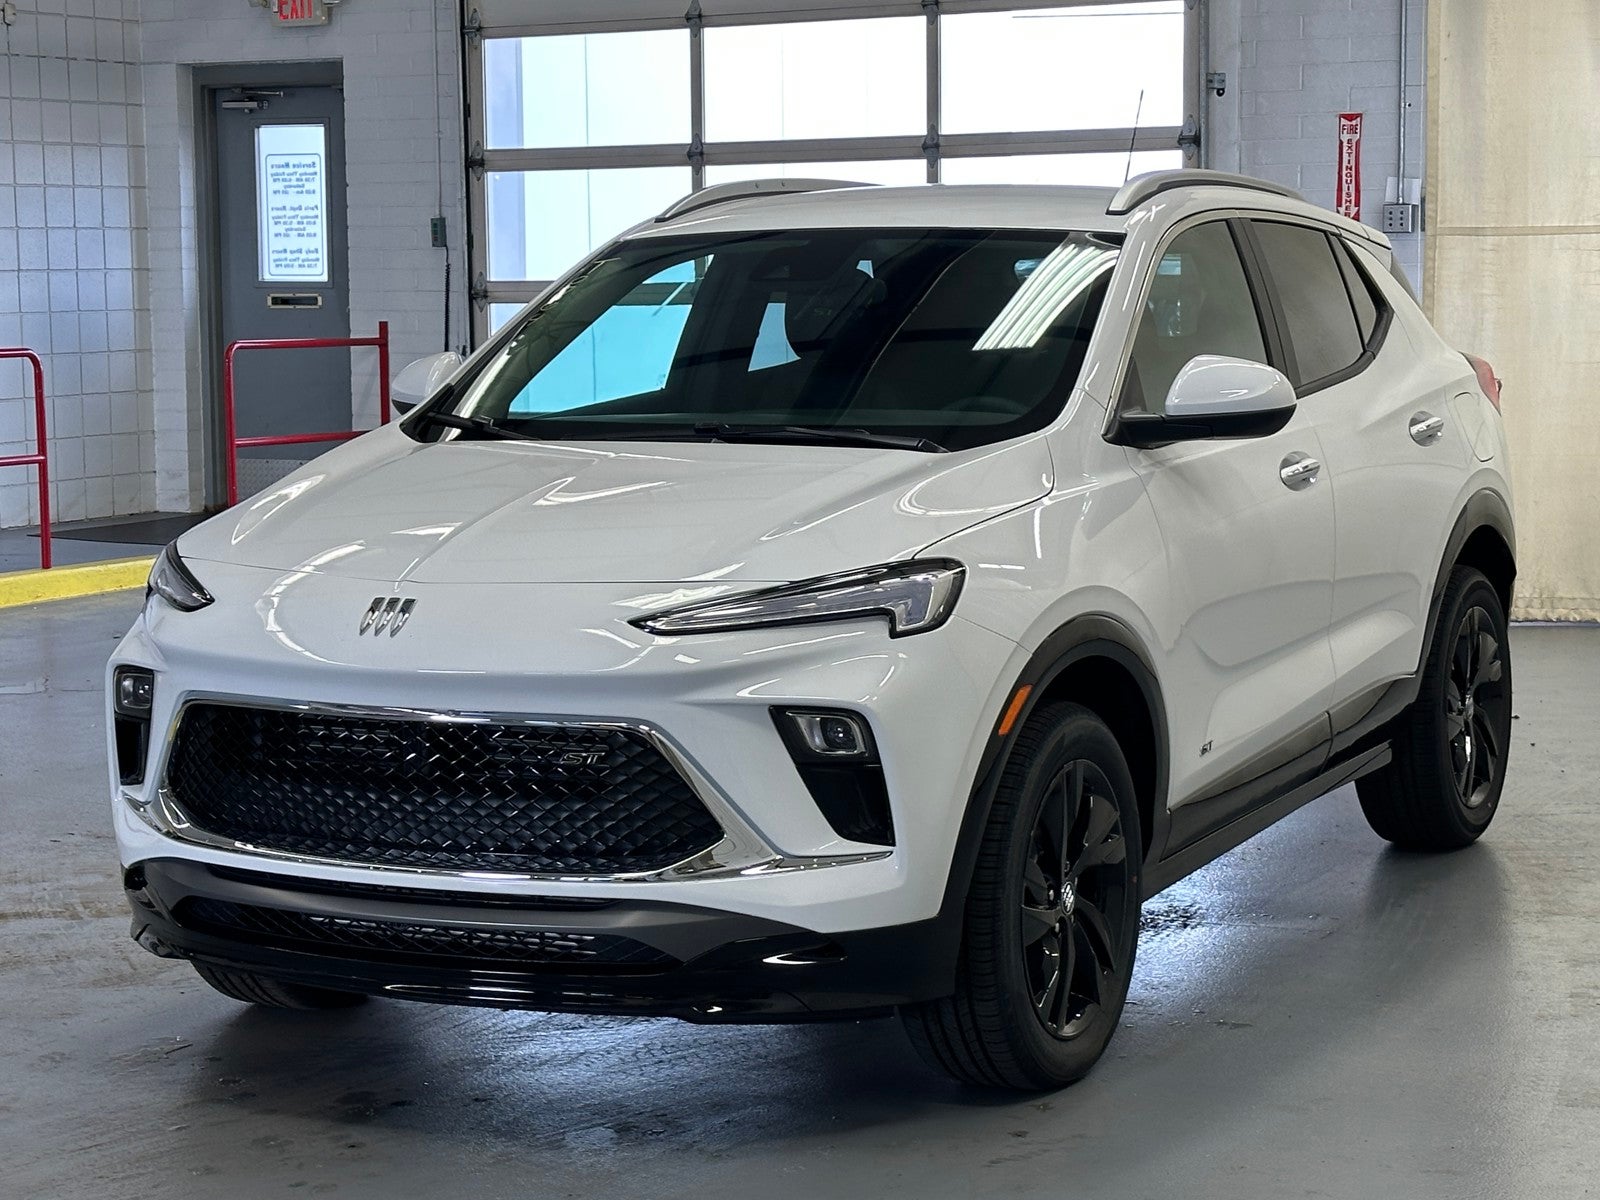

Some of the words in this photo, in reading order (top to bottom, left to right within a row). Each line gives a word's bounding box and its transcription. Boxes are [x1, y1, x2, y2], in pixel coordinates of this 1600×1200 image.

[279, 0, 313, 20] EXIT
[1341, 123, 1359, 135] FIRE
[1344, 138, 1354, 218] EXTINGUISHER
[559, 752, 606, 764] ST
